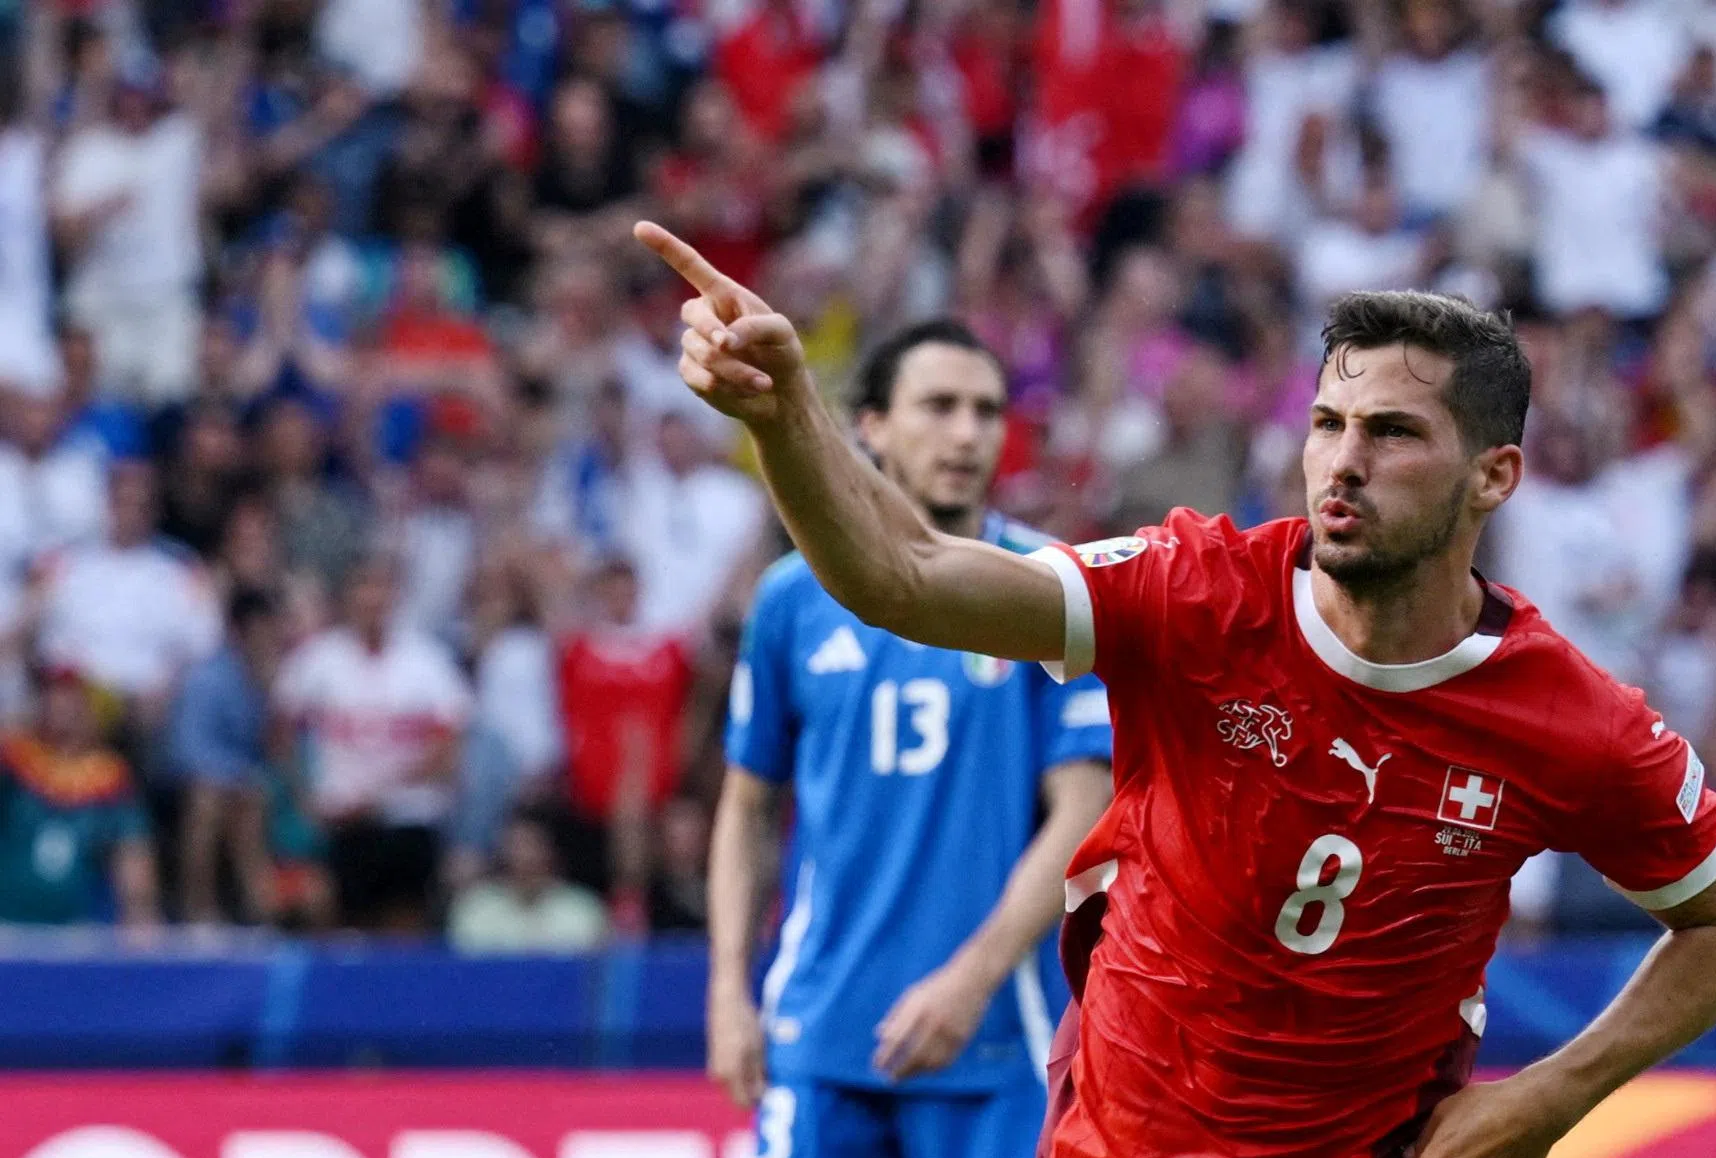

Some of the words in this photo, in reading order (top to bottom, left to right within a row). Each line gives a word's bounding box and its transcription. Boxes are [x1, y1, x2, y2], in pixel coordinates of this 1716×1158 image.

[871, 678, 950, 776] 13
[1434, 831, 1453, 846] SUI
[1463, 836, 1482, 850] ITA
[1275, 834, 1363, 955] 8
